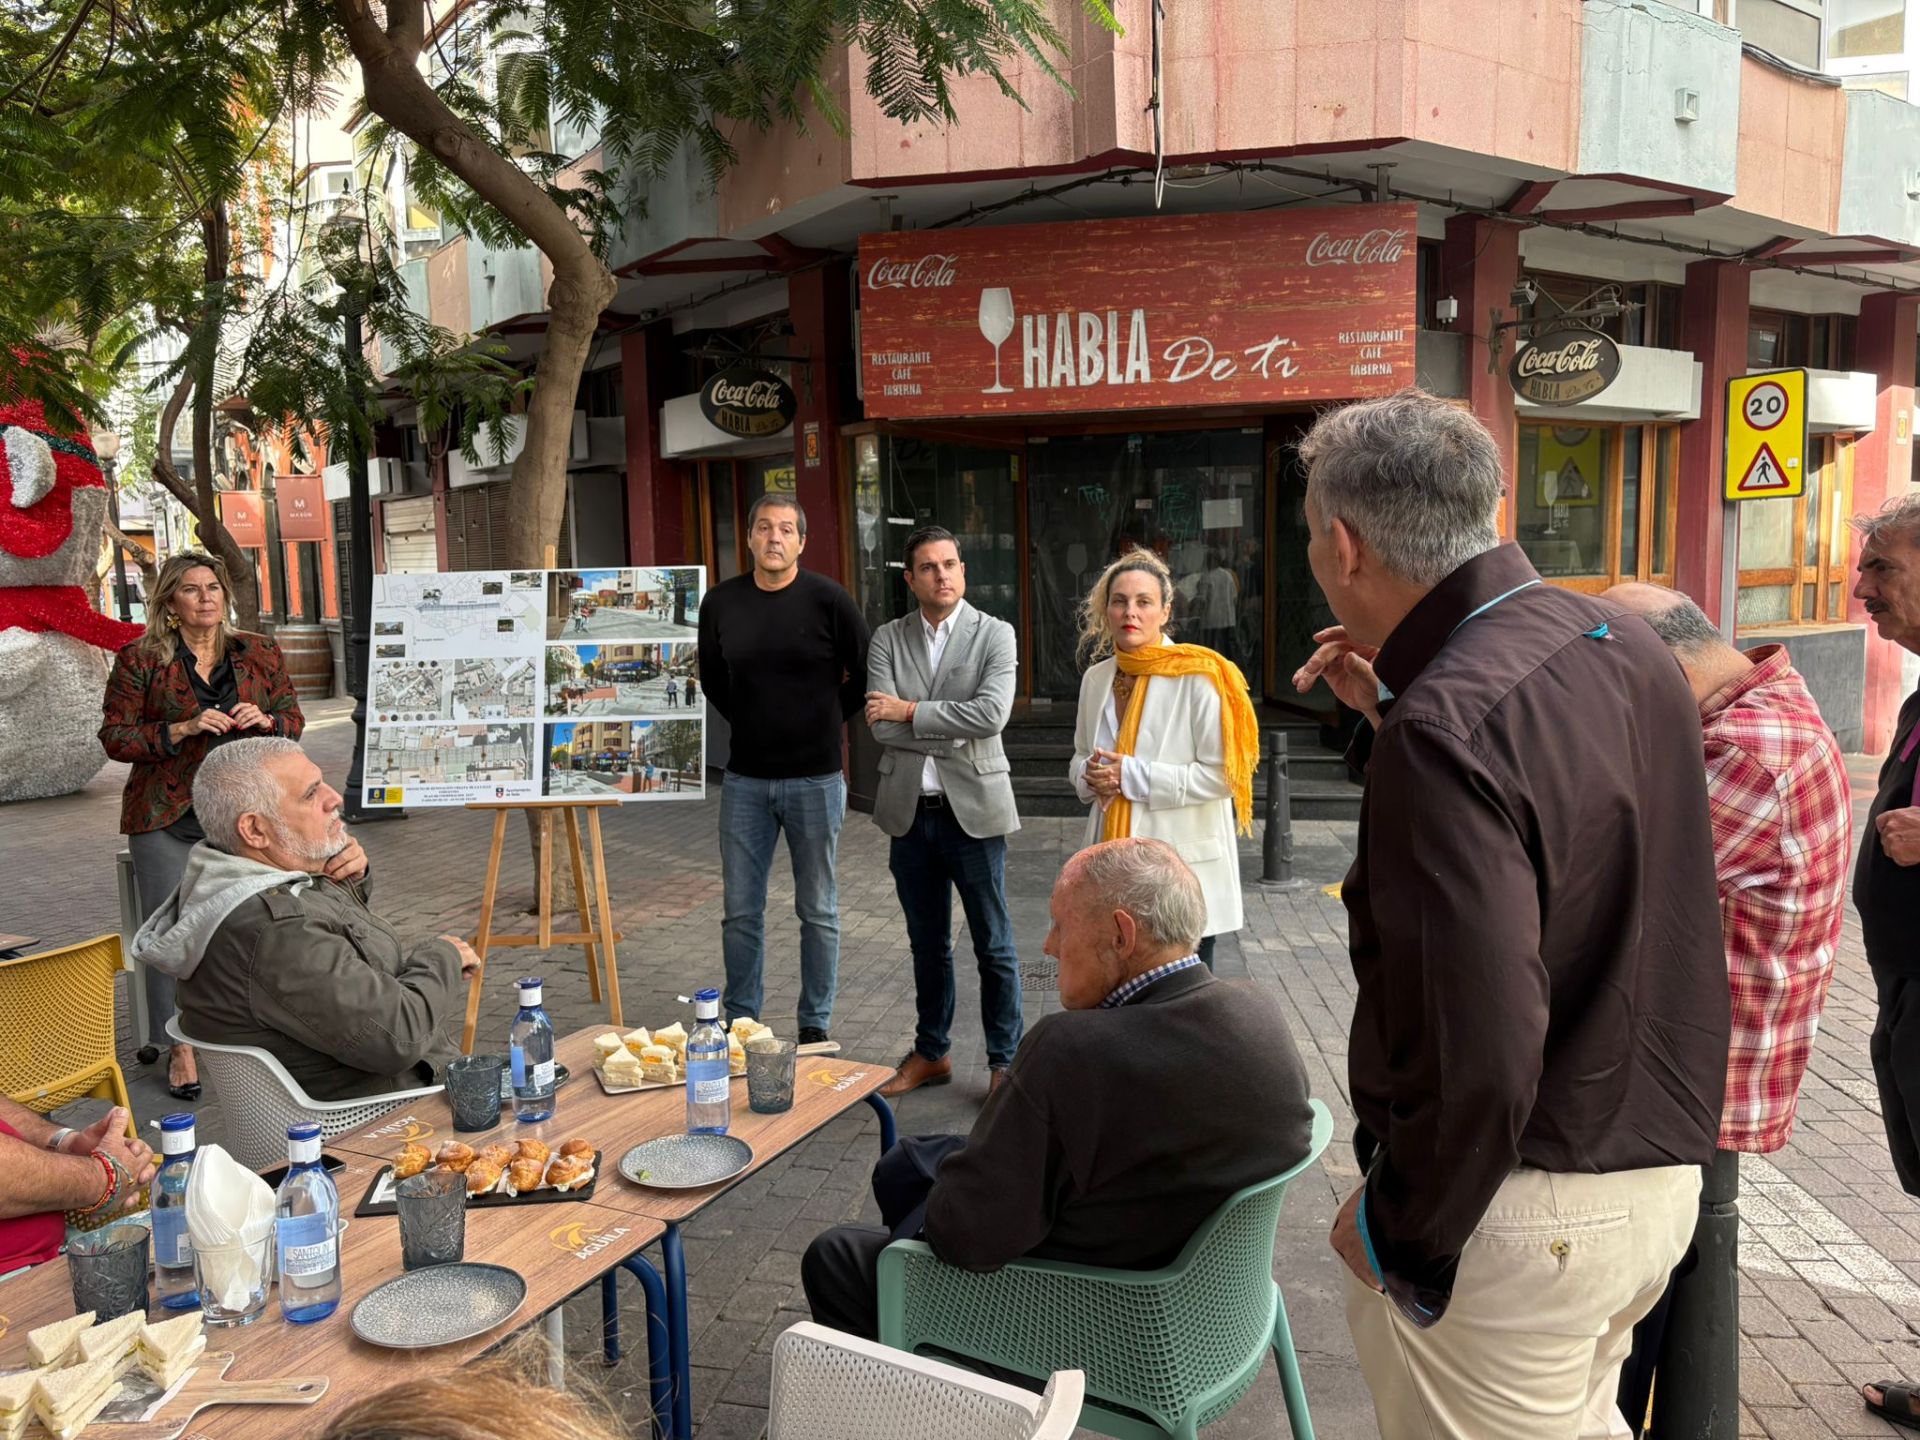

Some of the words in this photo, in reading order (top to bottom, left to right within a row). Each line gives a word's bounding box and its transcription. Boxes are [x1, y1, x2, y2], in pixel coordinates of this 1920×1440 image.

[1306, 229, 1408, 267] Coca-Cola
[868, 253, 959, 290] Coca-Cola
[1339, 330, 1404, 344] RESTAURANTE
[872, 352, 931, 365] RESTAURANTE
[1023, 308, 1150, 388] HABLA
[1163, 336, 1237, 383] De
[1518, 338, 1602, 377] Coca-Cola
[1350, 363, 1393, 376] TABERNA
[711, 379, 782, 409] Coca-Cola
[883, 383, 922, 396] TABERNA
[1530, 379, 1560, 400] HABLA
[1750, 396, 1782, 416] 20
[721, 410, 751, 432] HABLA
